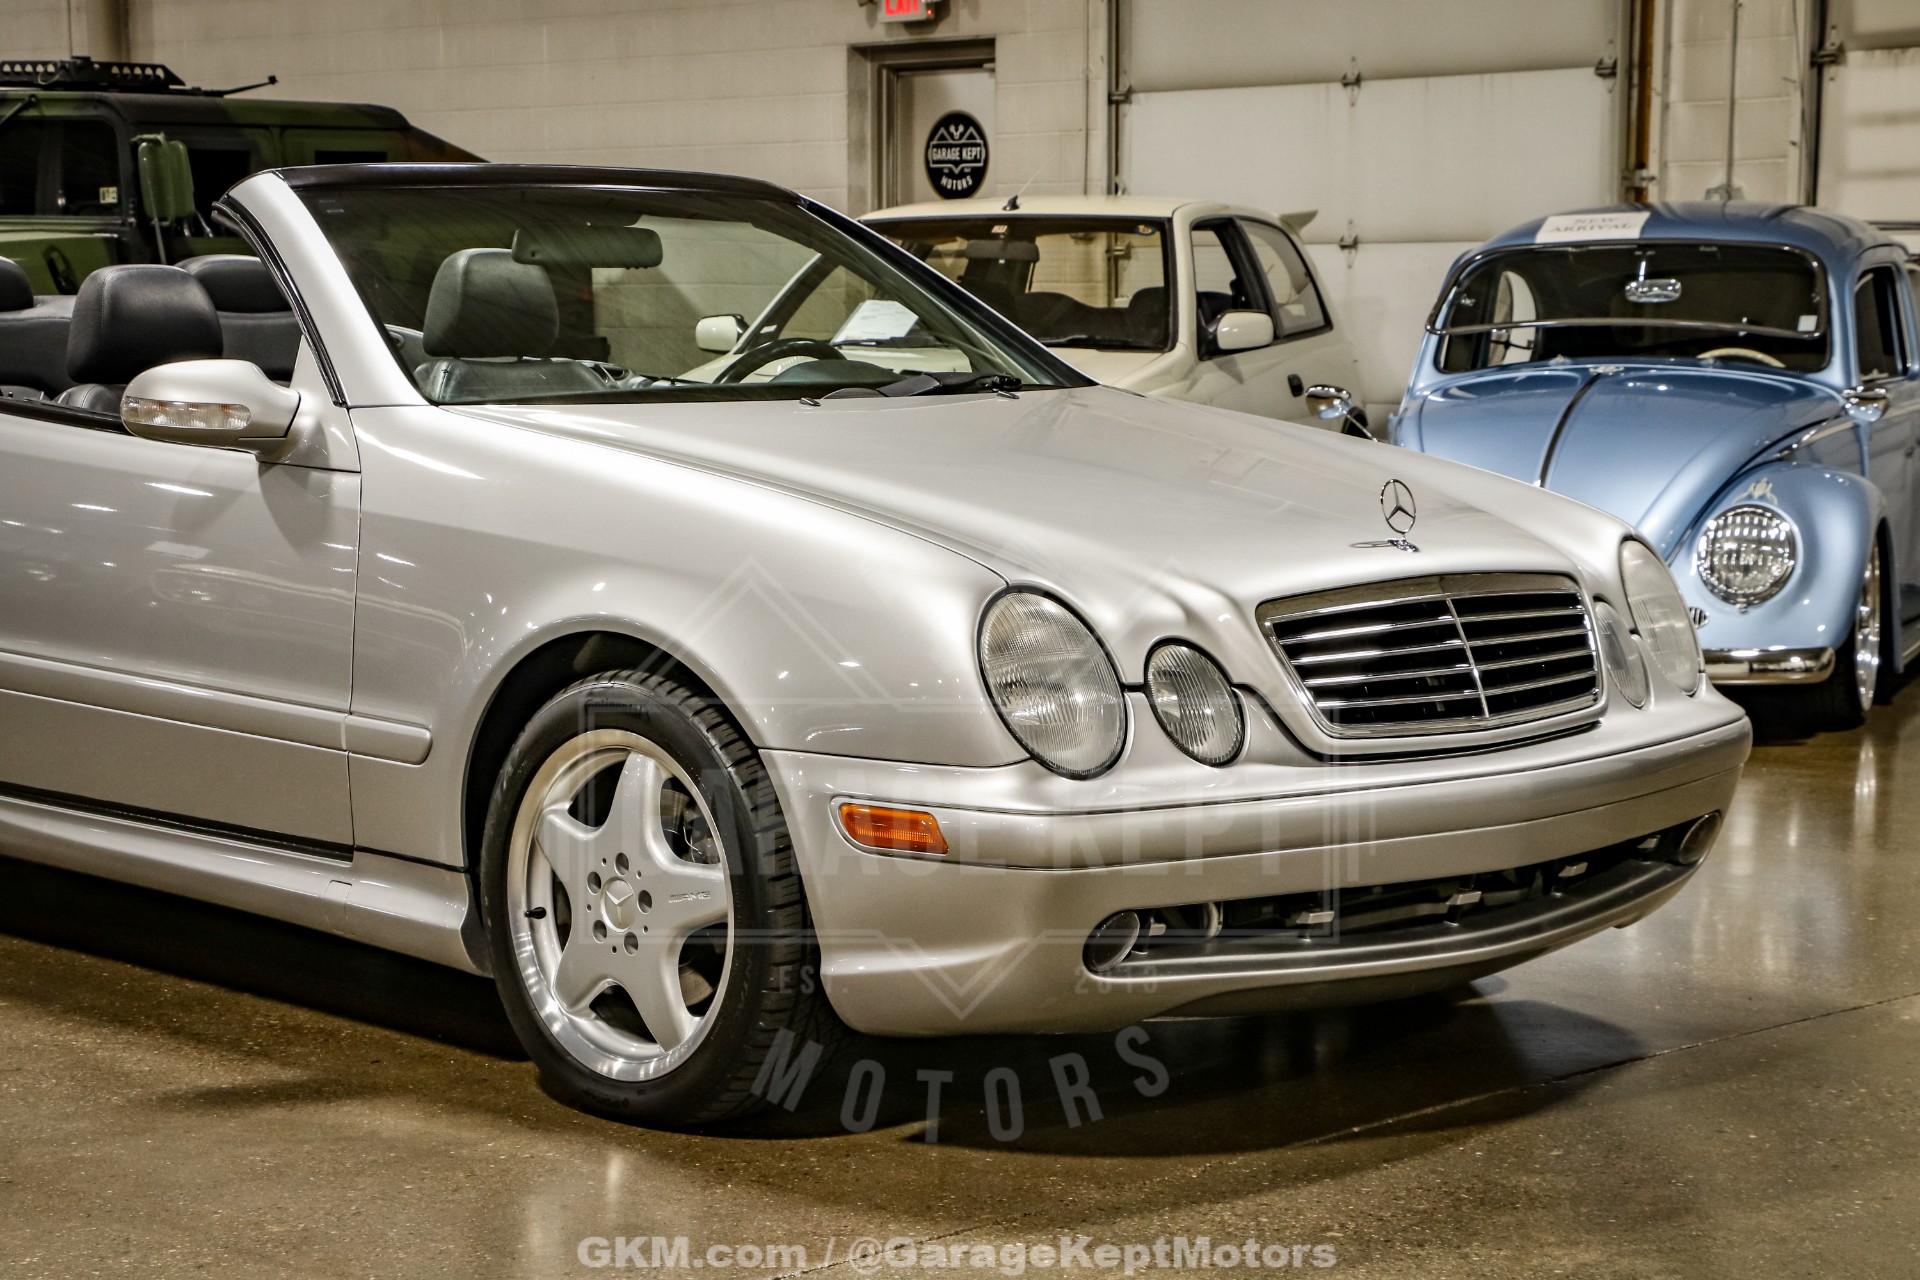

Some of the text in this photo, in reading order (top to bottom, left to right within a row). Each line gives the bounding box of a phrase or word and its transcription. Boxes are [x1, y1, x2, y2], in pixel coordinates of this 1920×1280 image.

[932, 146, 980, 160] GARAGE KEPT
[940, 175, 973, 190] MOTORS
[1548, 223, 1632, 232] ARRIVAL
